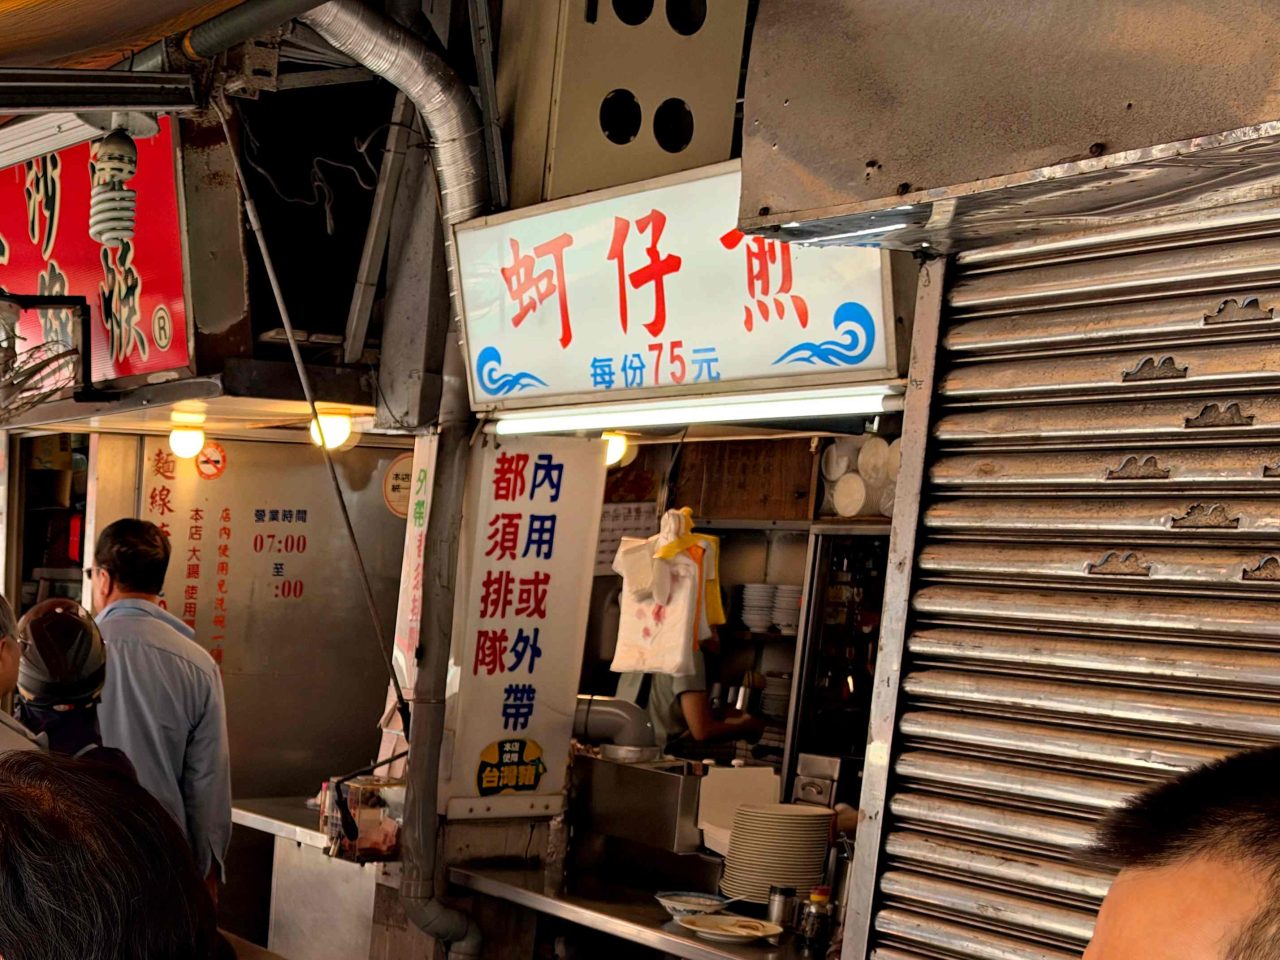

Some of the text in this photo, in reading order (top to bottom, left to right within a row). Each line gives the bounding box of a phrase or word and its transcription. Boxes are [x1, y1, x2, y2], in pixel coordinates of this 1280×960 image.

[501, 208, 809, 350] 蚵仔煎
[590, 340, 721, 391] 每份75元
[254, 509, 308, 523] 營業時間
[253, 534, 307, 553] 07:00
[473, 451, 529, 677] 都須排隊
[272, 563, 284, 577] 至
[502, 453, 564, 732] 內用或外帶
